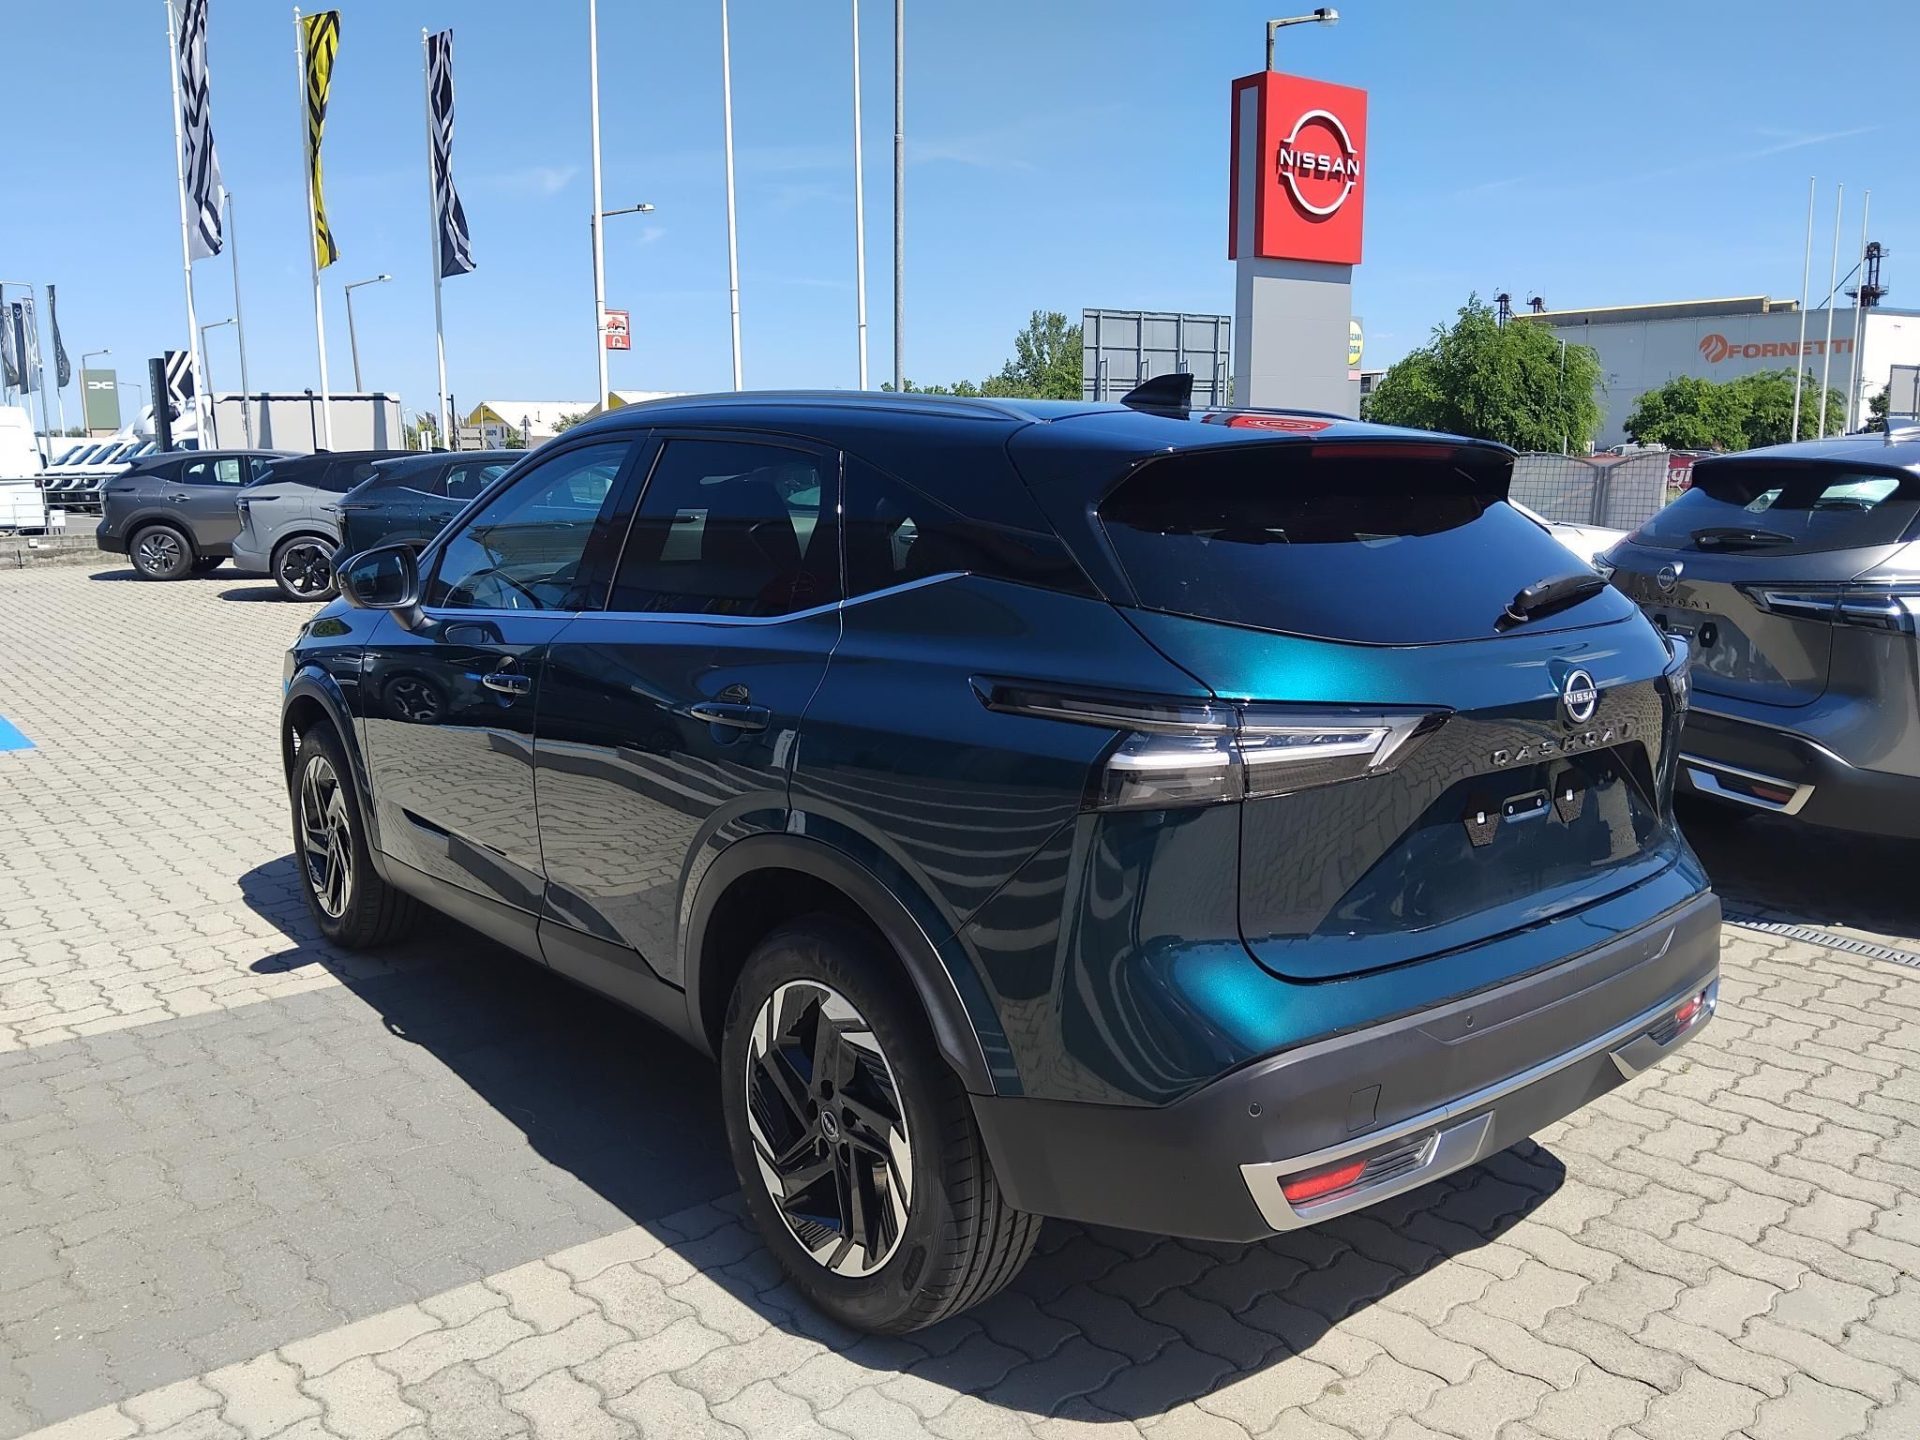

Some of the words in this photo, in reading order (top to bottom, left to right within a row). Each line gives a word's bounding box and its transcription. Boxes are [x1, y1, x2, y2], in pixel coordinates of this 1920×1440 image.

[1280, 148, 1360, 176] NISSAN
[1727, 338, 1854, 359] FORNETTI
[1564, 689, 1597, 704] NISSAN
[1490, 722, 1634, 766] QASHQAI
